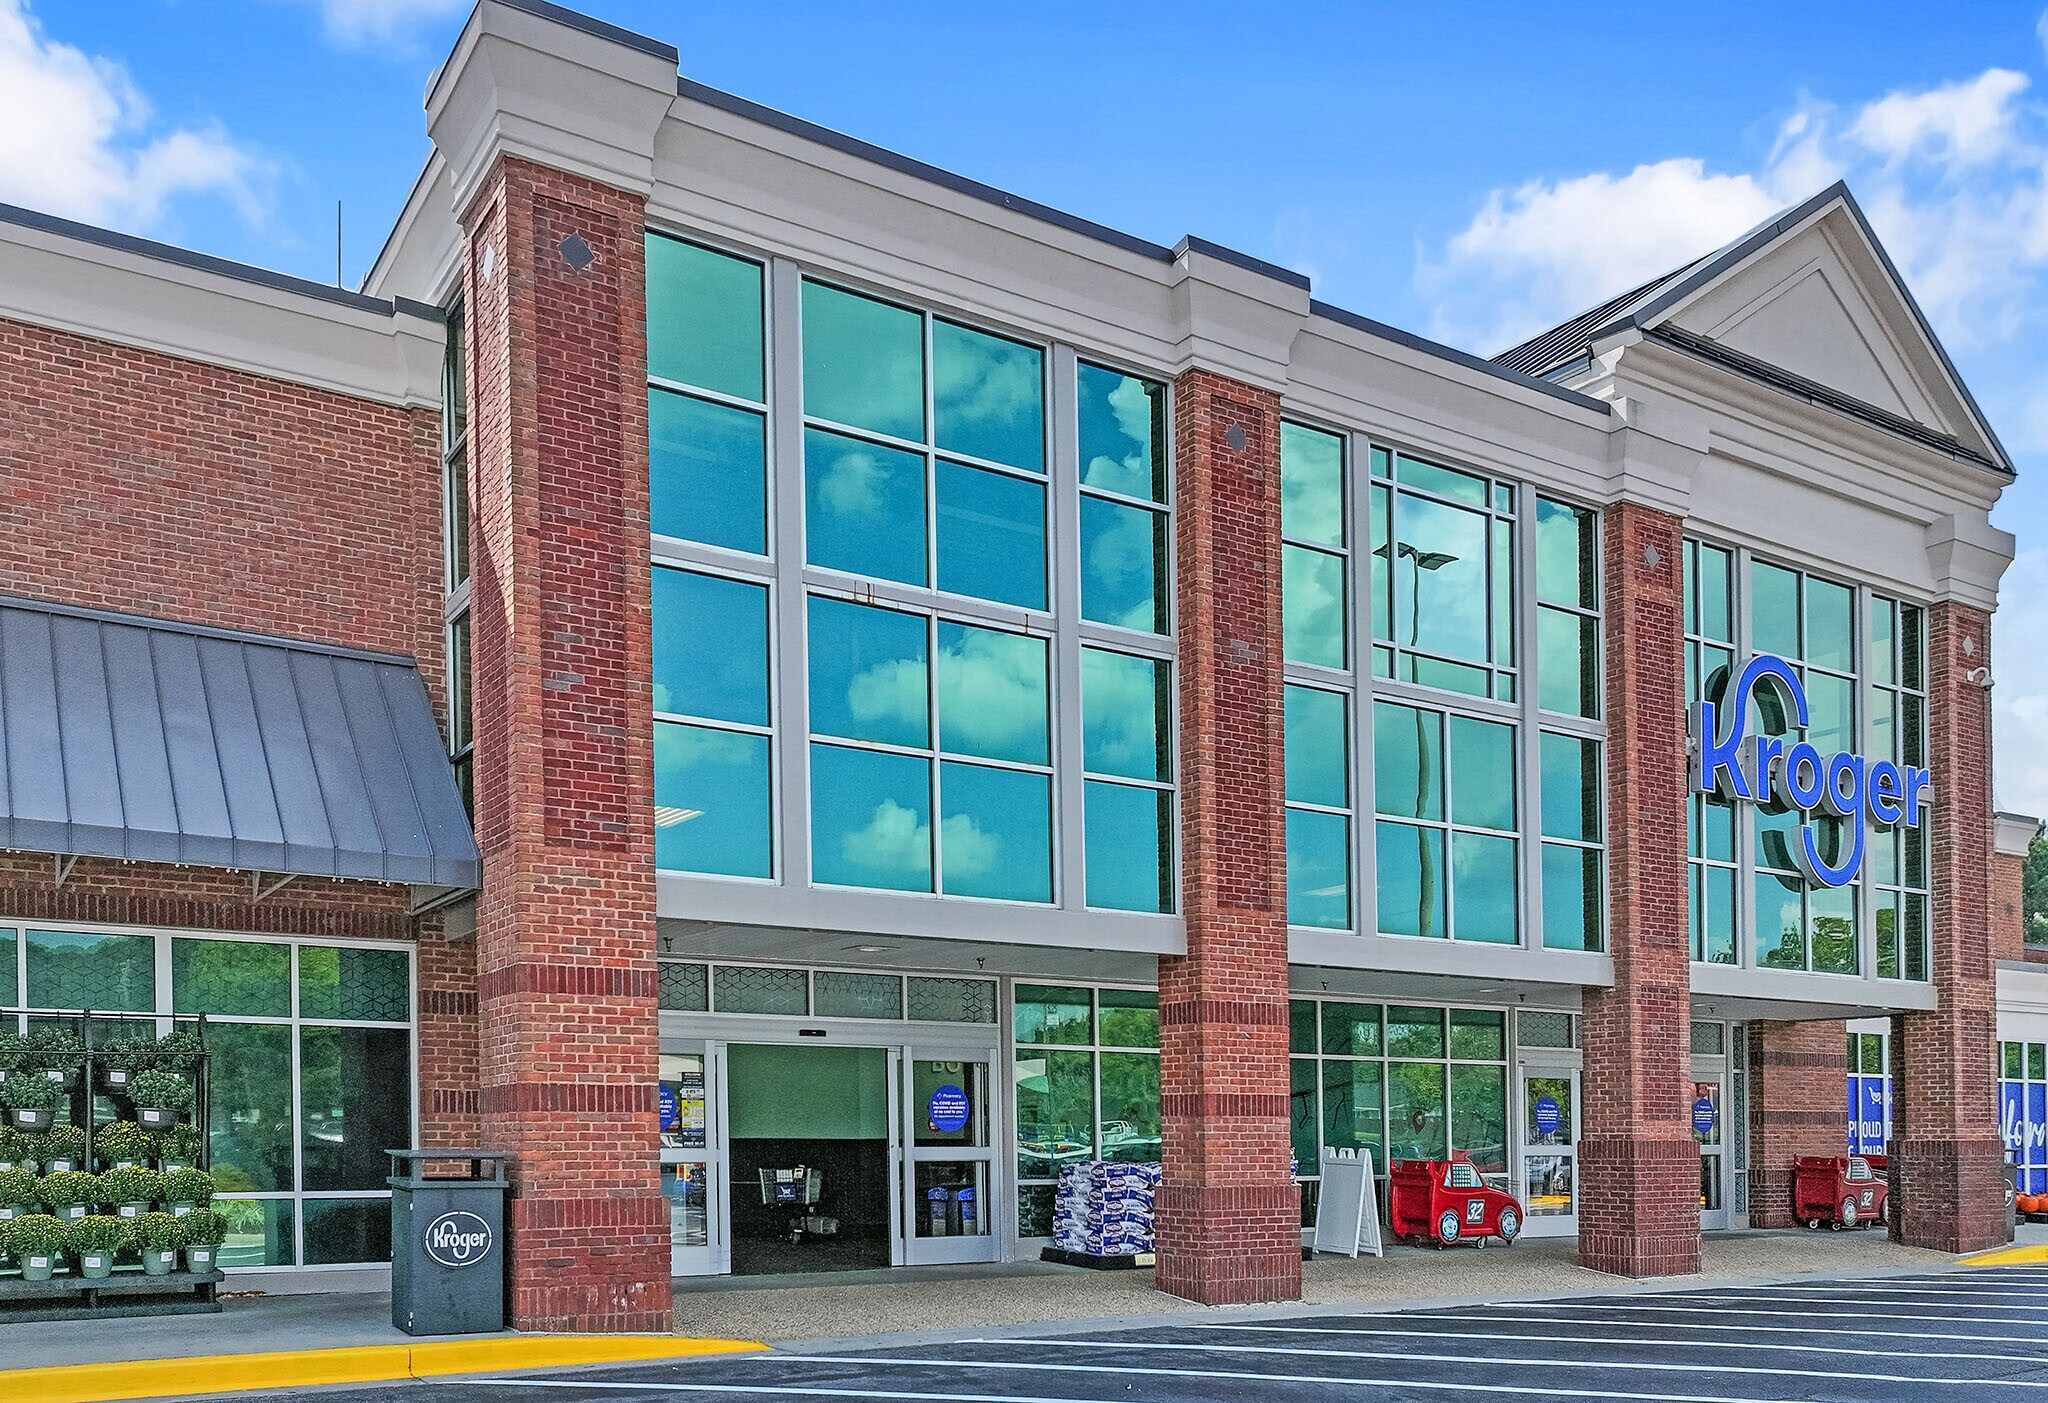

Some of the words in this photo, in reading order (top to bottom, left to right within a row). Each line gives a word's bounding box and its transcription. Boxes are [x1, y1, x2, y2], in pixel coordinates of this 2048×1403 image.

[1698, 655, 1930, 888] Kroger
[1468, 1202, 1485, 1220] 32
[1861, 1191, 1874, 1206] 32
[433, 1220, 487, 1259] Kroger
